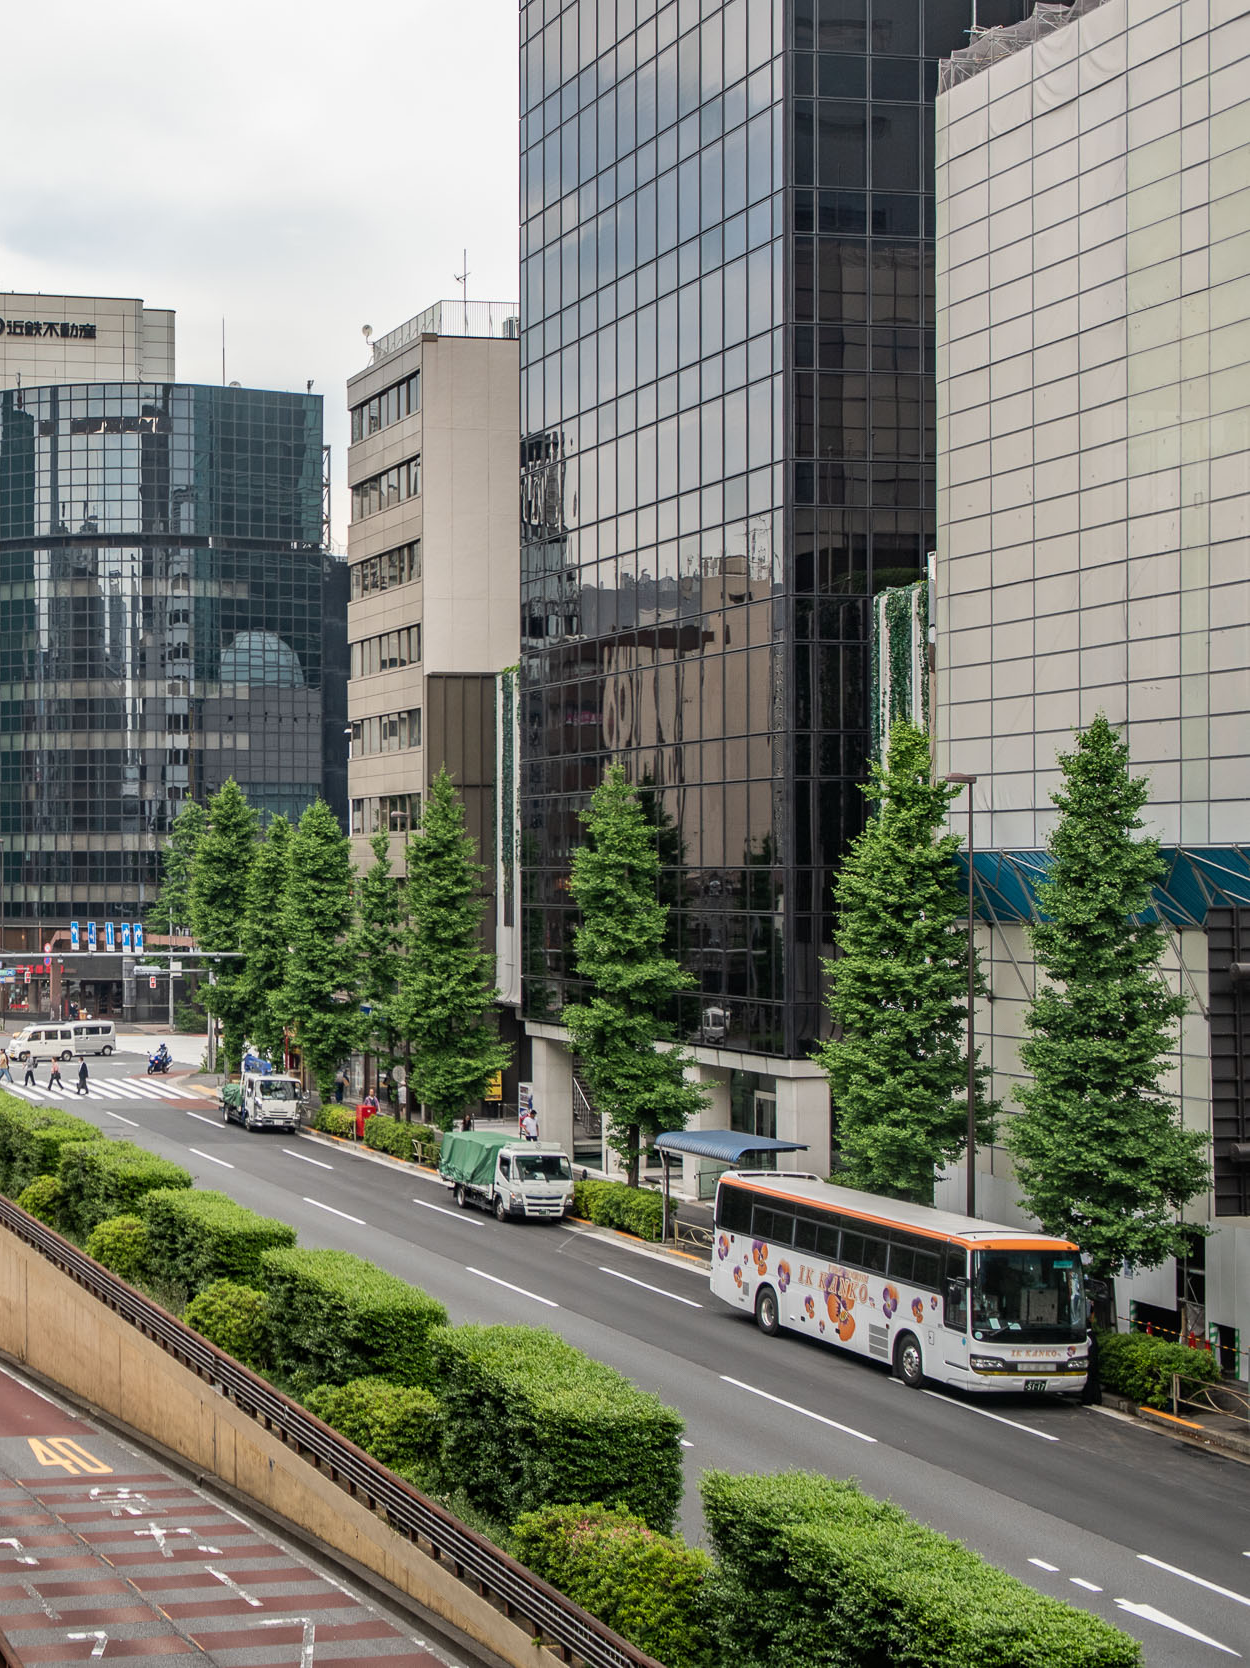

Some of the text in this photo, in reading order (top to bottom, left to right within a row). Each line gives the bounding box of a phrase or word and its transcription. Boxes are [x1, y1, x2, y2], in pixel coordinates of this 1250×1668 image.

[6, 320, 97, 339] 近鉄不動産
[798, 1264, 814, 1286] IK
[817, 1271, 868, 1304] KANKO
[28, 1438, 113, 1474] 40
